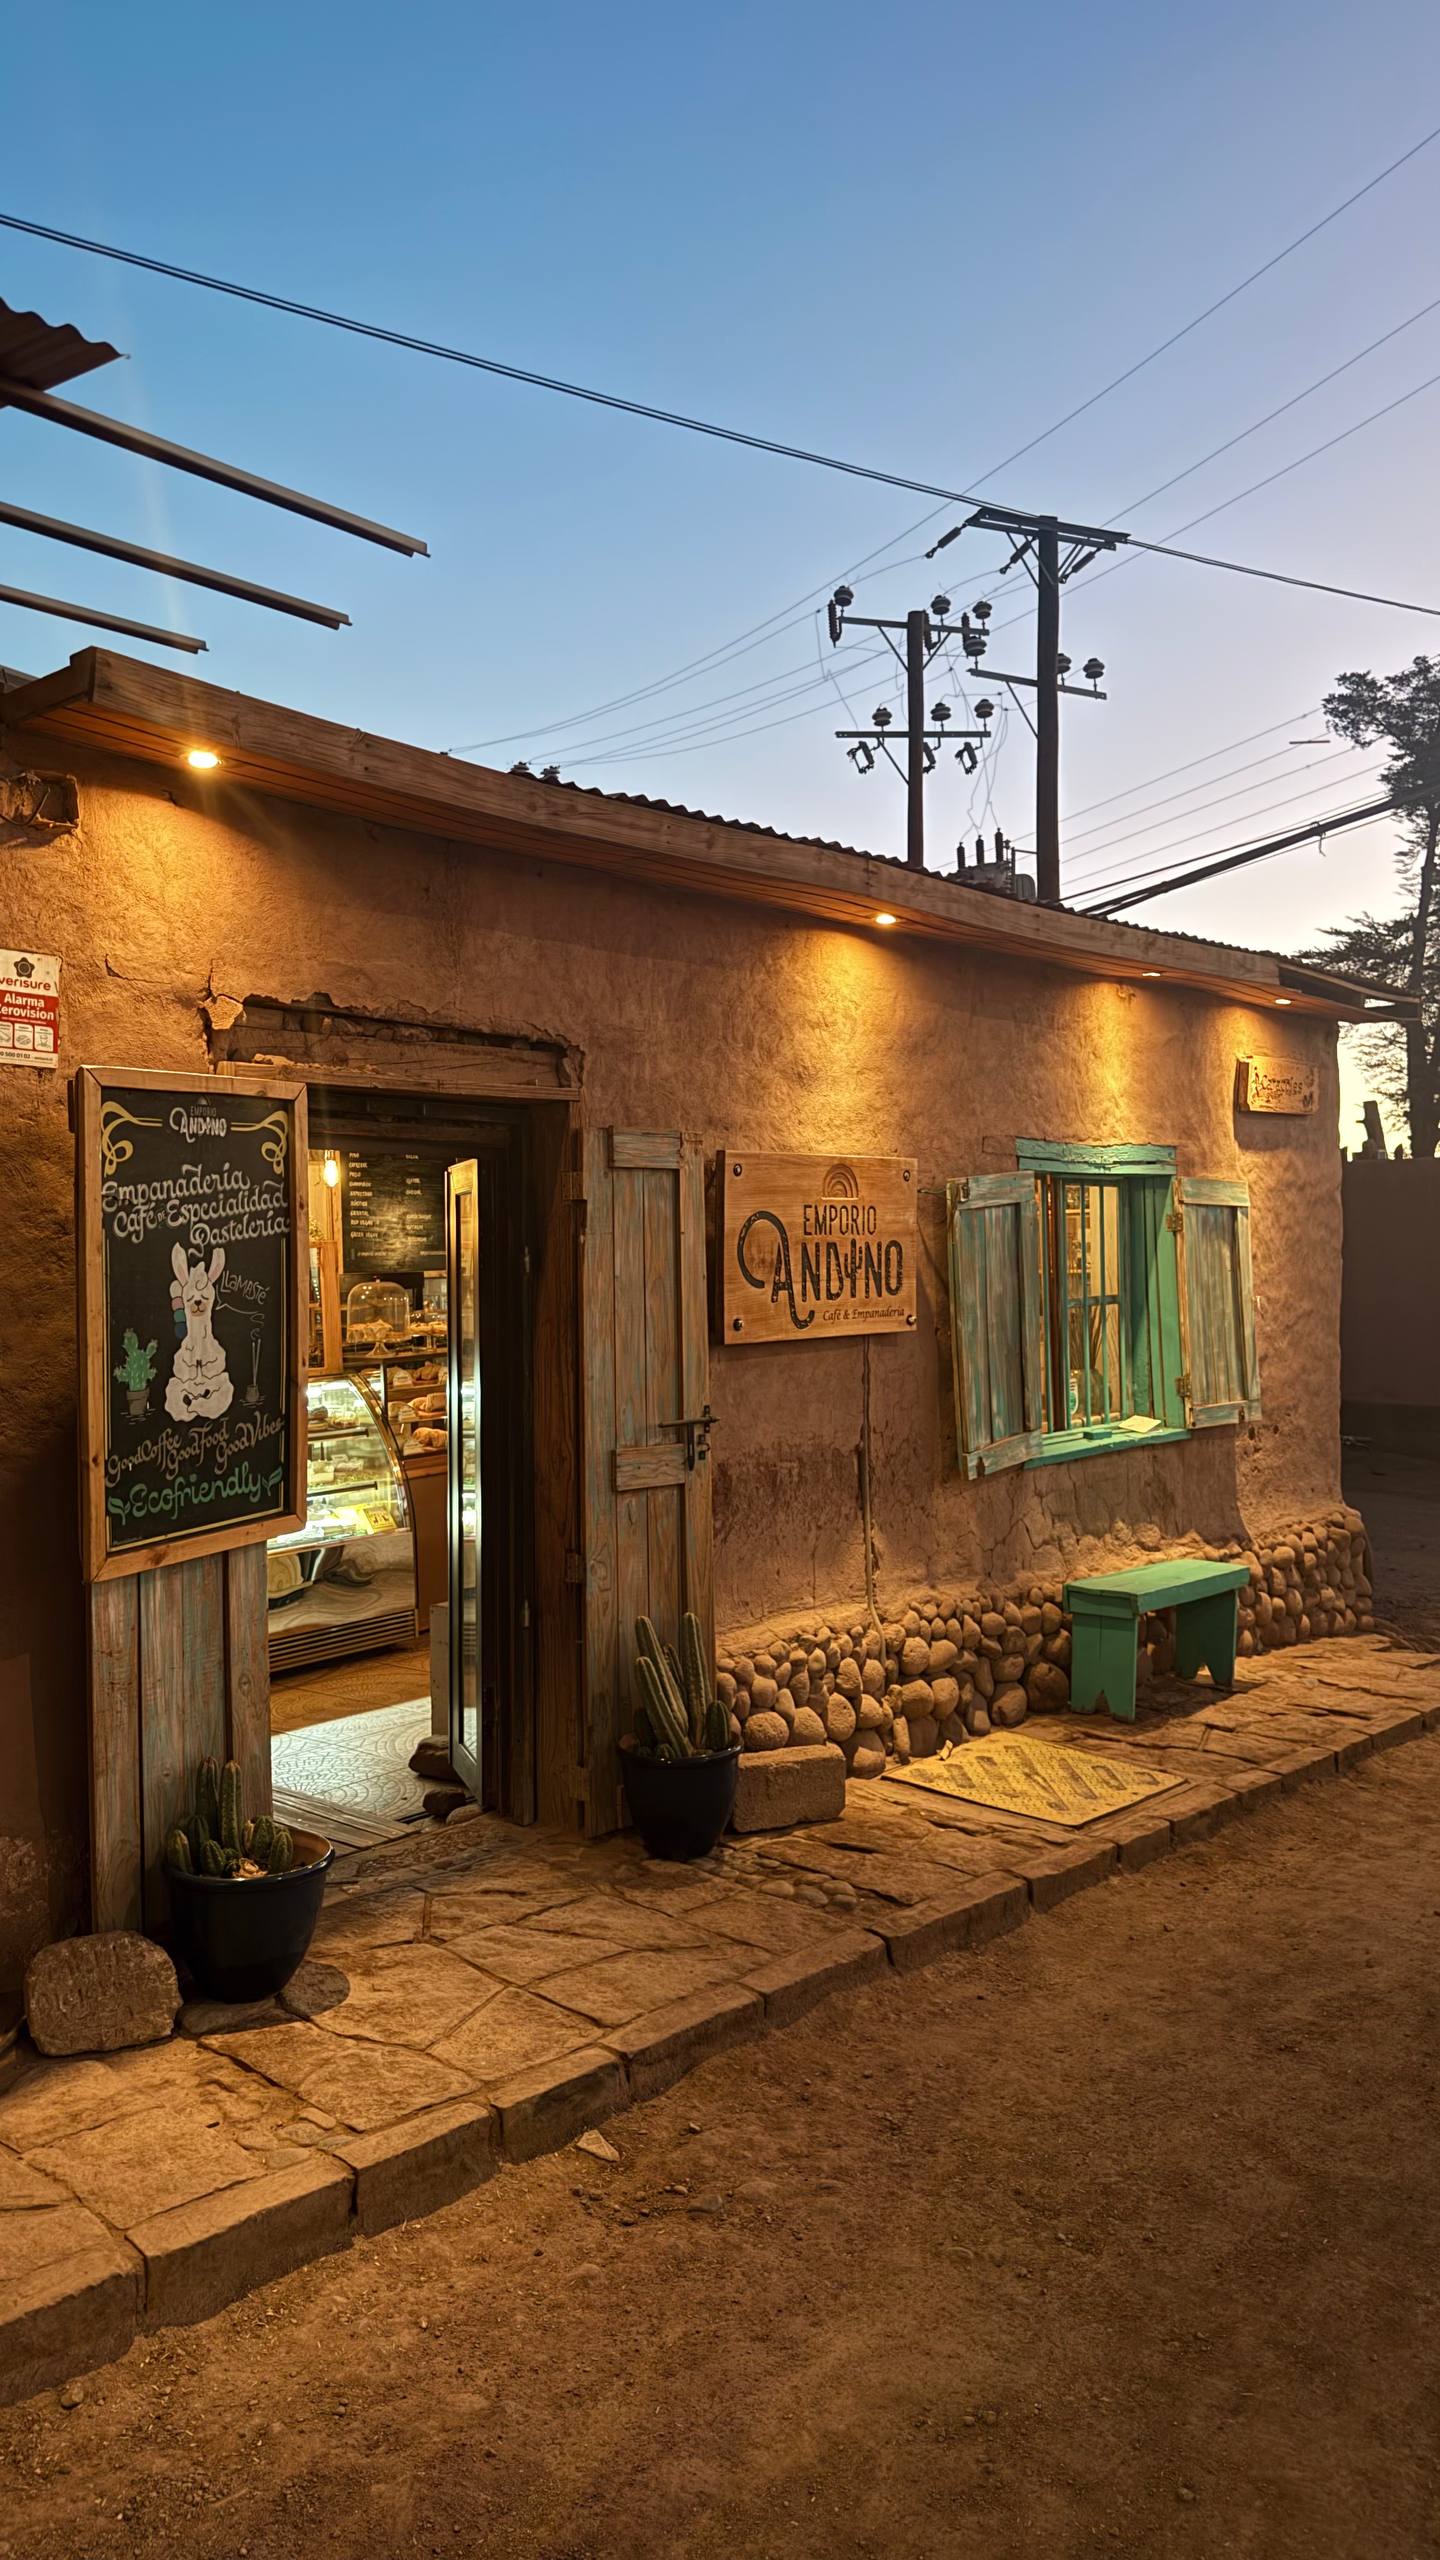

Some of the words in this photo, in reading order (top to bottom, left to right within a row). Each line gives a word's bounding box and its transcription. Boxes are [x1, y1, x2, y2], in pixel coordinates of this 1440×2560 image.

[0, 976, 51, 991] verisure
[4, 993, 45, 1008] Alarma
[0, 1003, 54, 1021] erovision
[169, 1107, 228, 1143] ANDINO
[101, 1162, 250, 1212] Empanadería
[113, 1202, 157, 1243] Café
[166, 1180, 287, 1233] Especialidad
[803, 1204, 877, 1236] EMPORIO
[736, 1210, 904, 1330] ANDINO
[843, 1309, 851, 1320] &
[129, 1461, 261, 1520] Ecofriendly
